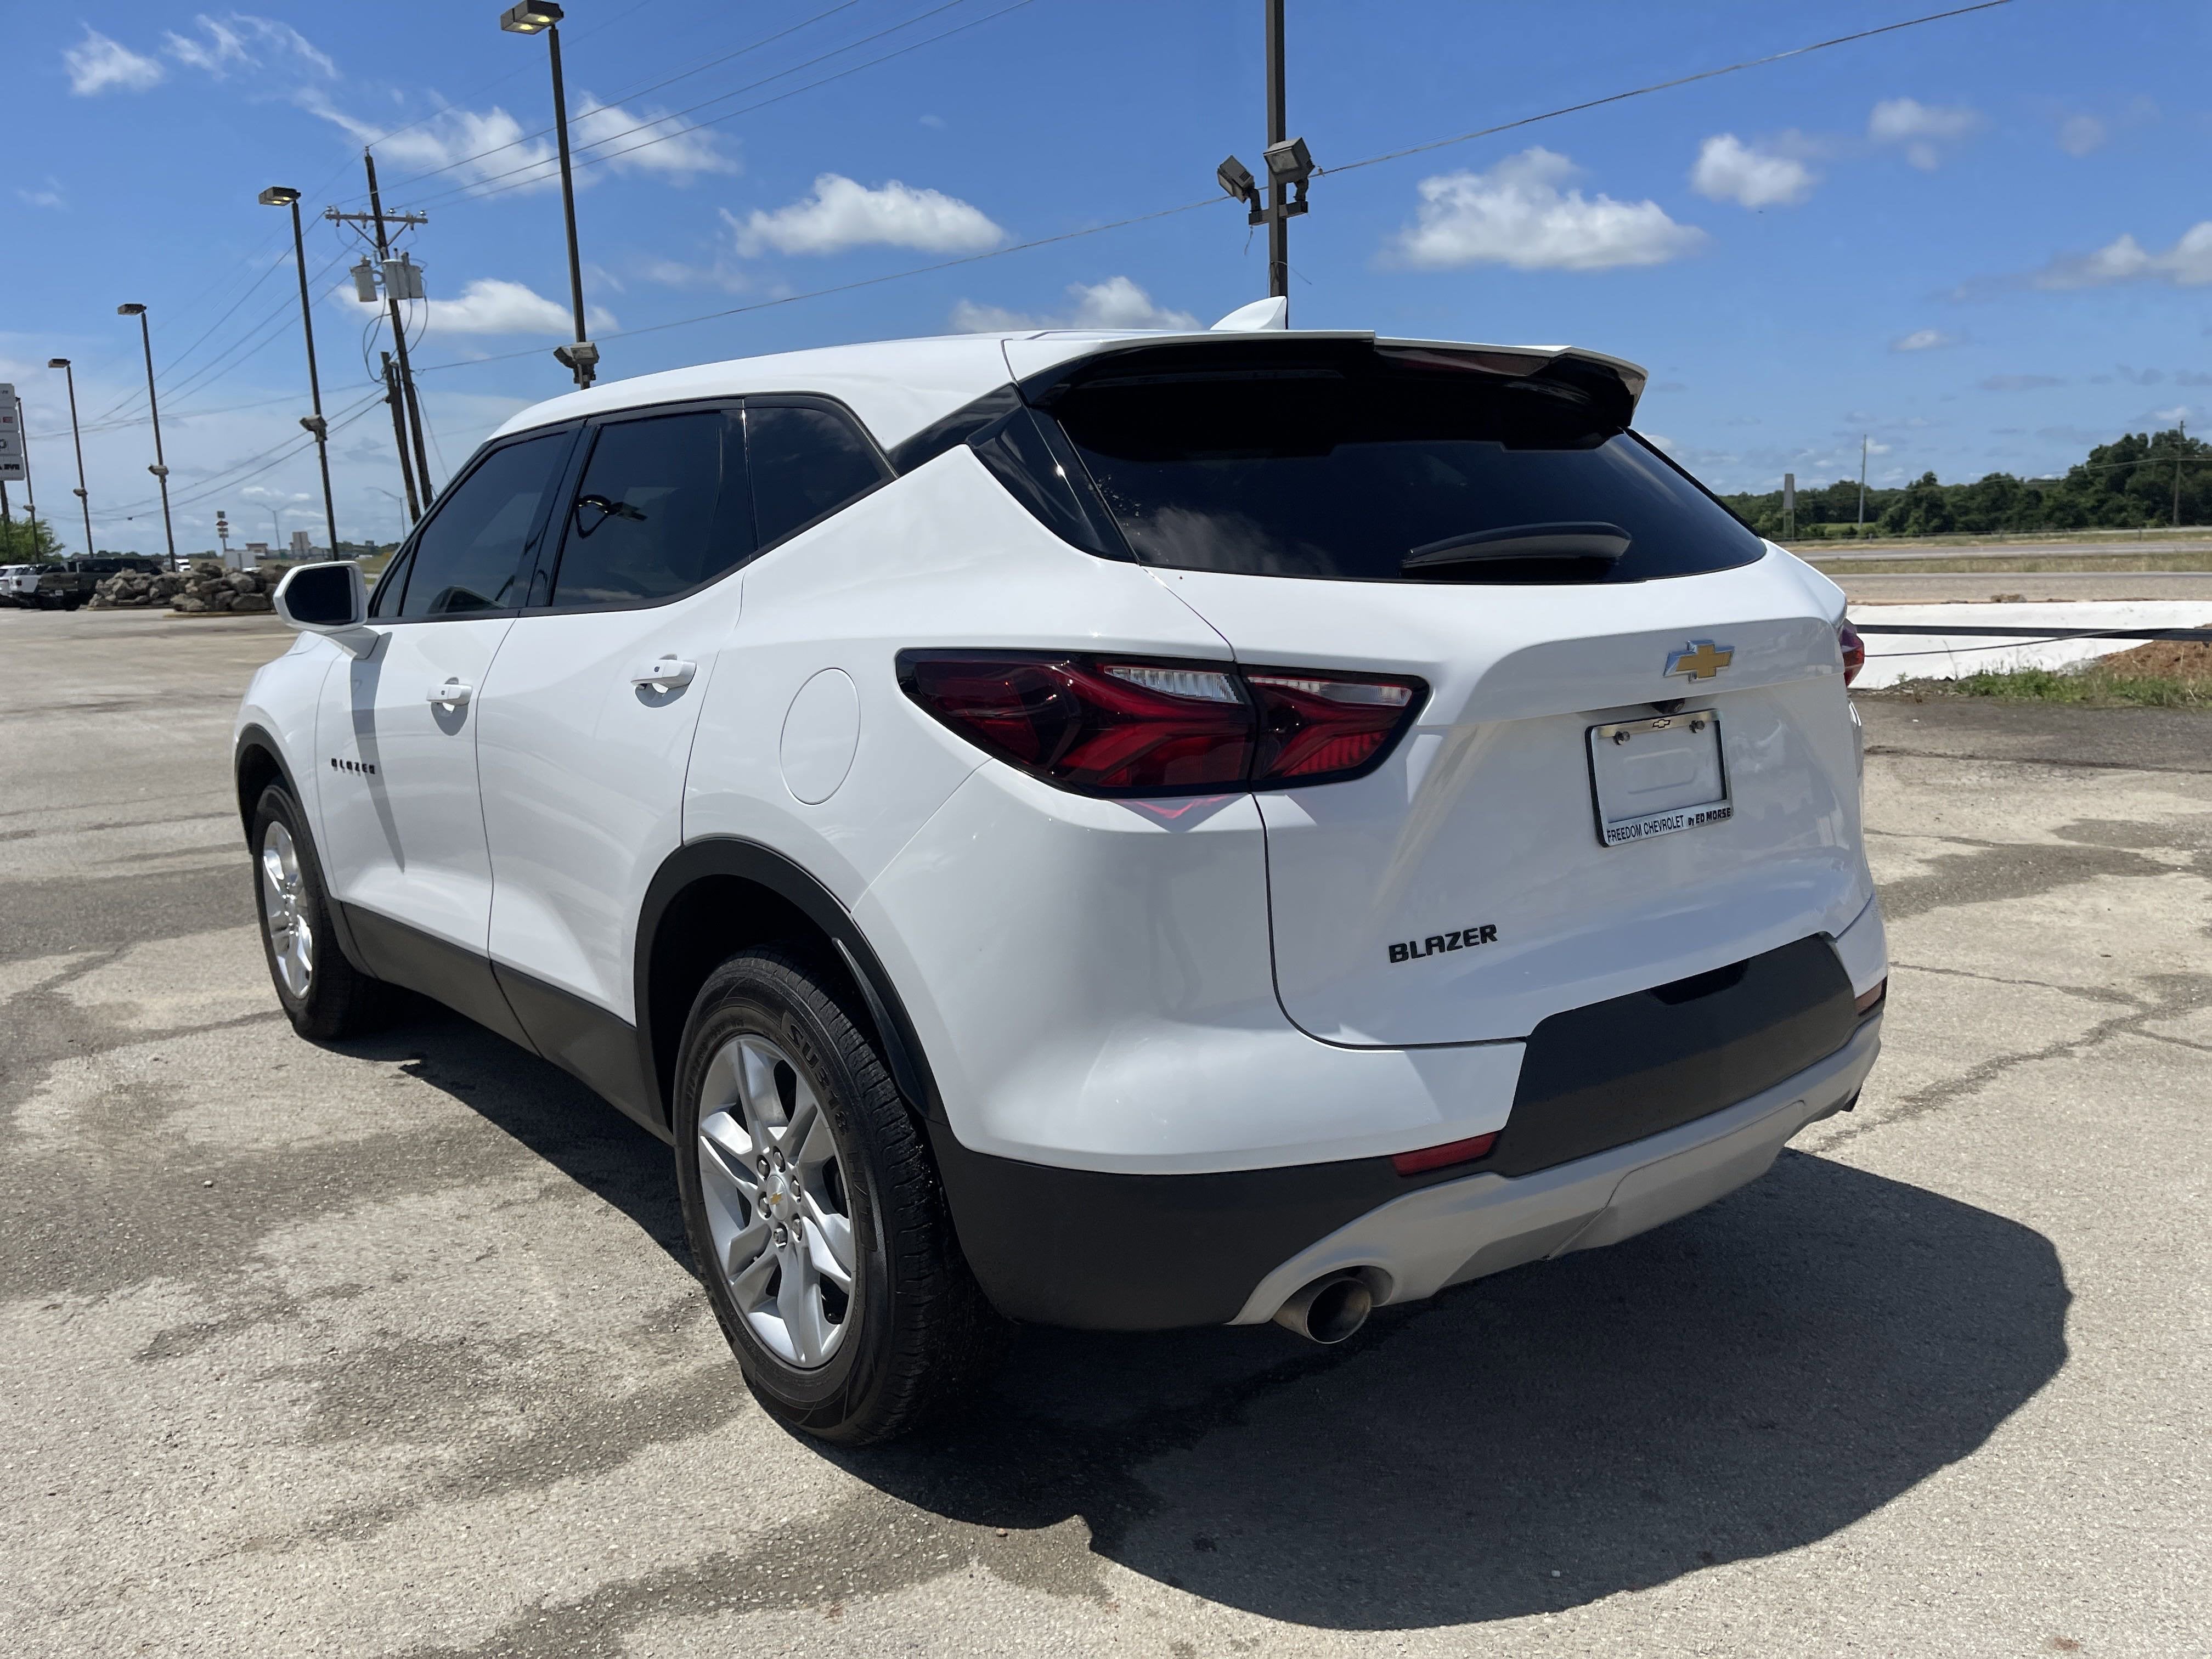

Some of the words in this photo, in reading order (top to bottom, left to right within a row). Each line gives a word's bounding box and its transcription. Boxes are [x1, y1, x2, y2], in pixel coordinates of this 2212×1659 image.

[1606, 823, 1643, 843] FREEDOM
[1644, 815, 1684, 835] CHEVROLET
[1695, 812, 1706, 823] ED
[1706, 807, 1731, 821] MORSE
[1389, 924, 1498, 963] BLAZER
